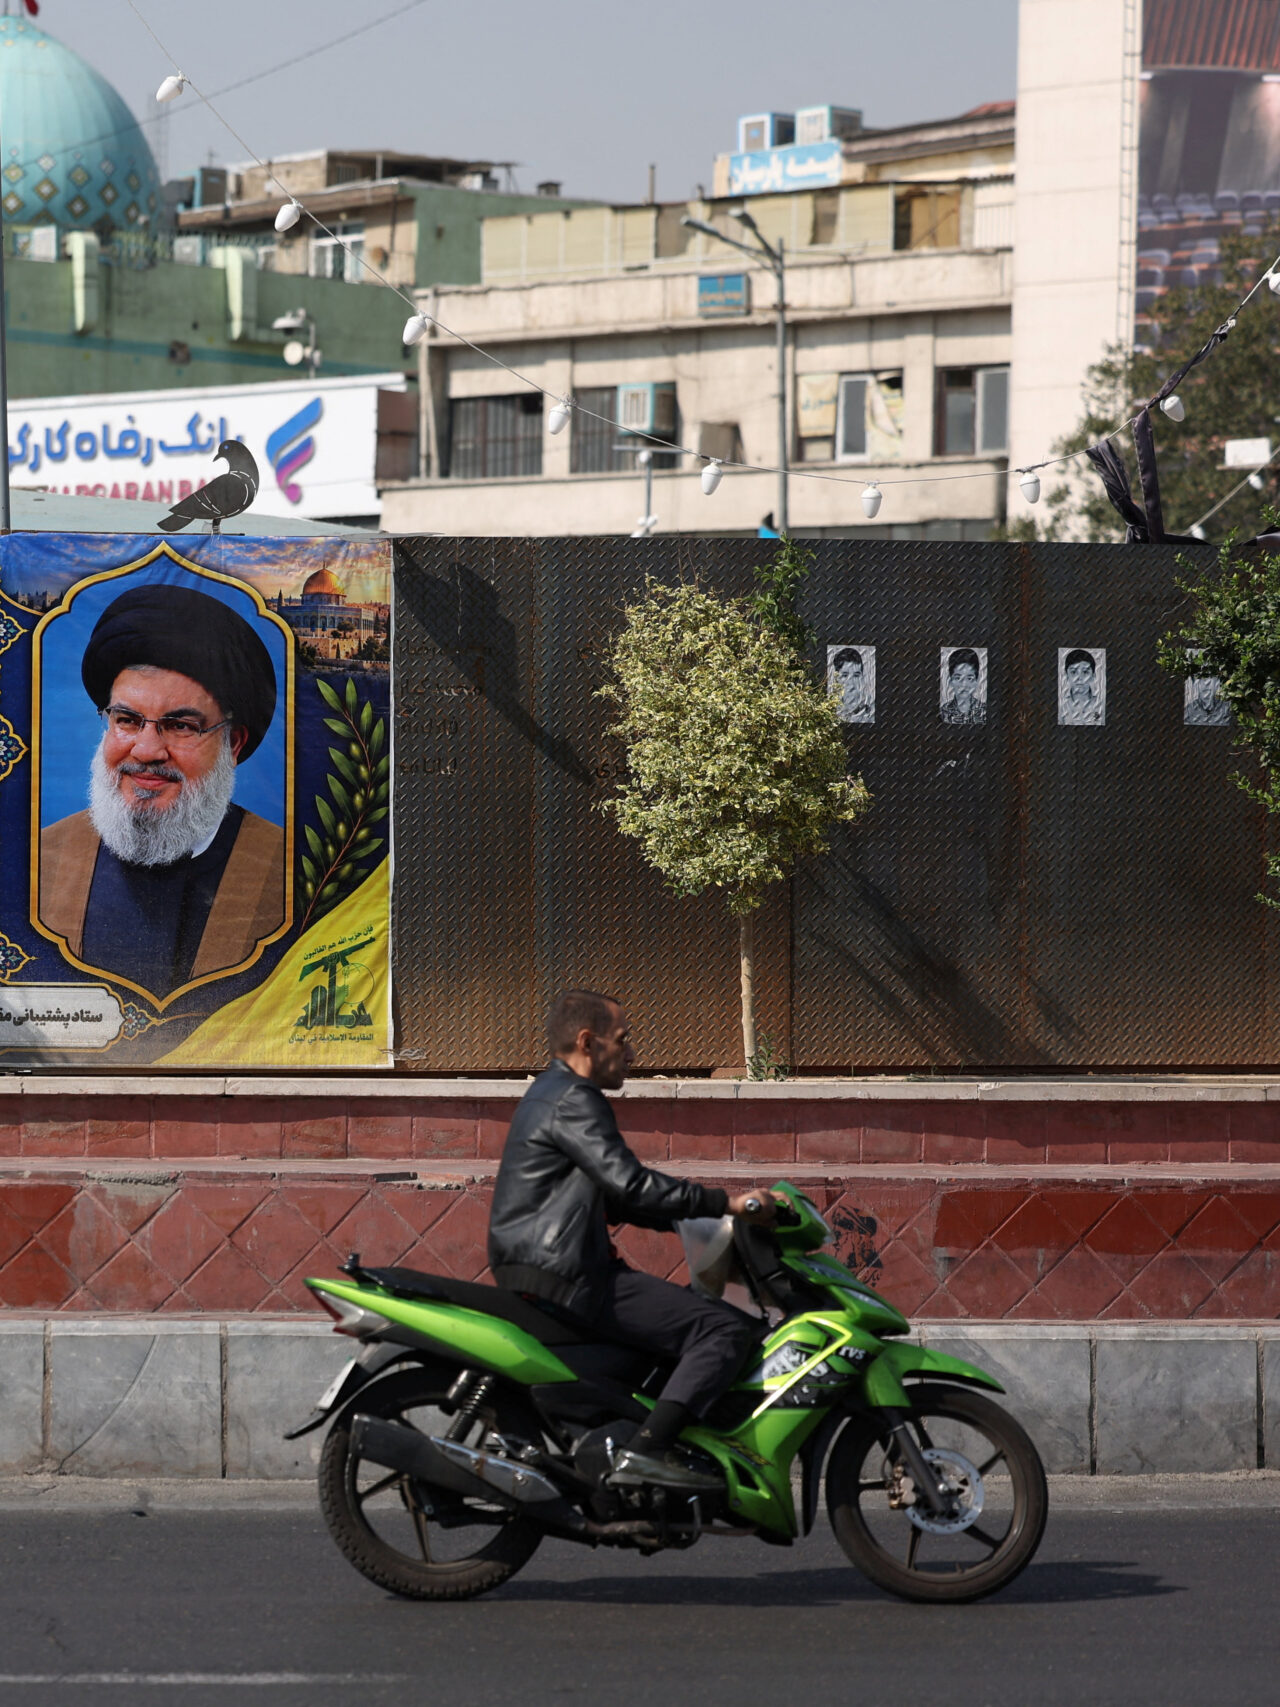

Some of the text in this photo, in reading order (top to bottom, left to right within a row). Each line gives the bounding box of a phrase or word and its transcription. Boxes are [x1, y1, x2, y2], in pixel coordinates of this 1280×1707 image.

[74, 415, 153, 466] رفاه
[158, 411, 242, 456] انک
[13, 1008, 70, 1029] پشتیبانی
[71, 1009, 103, 1023] ستاد
